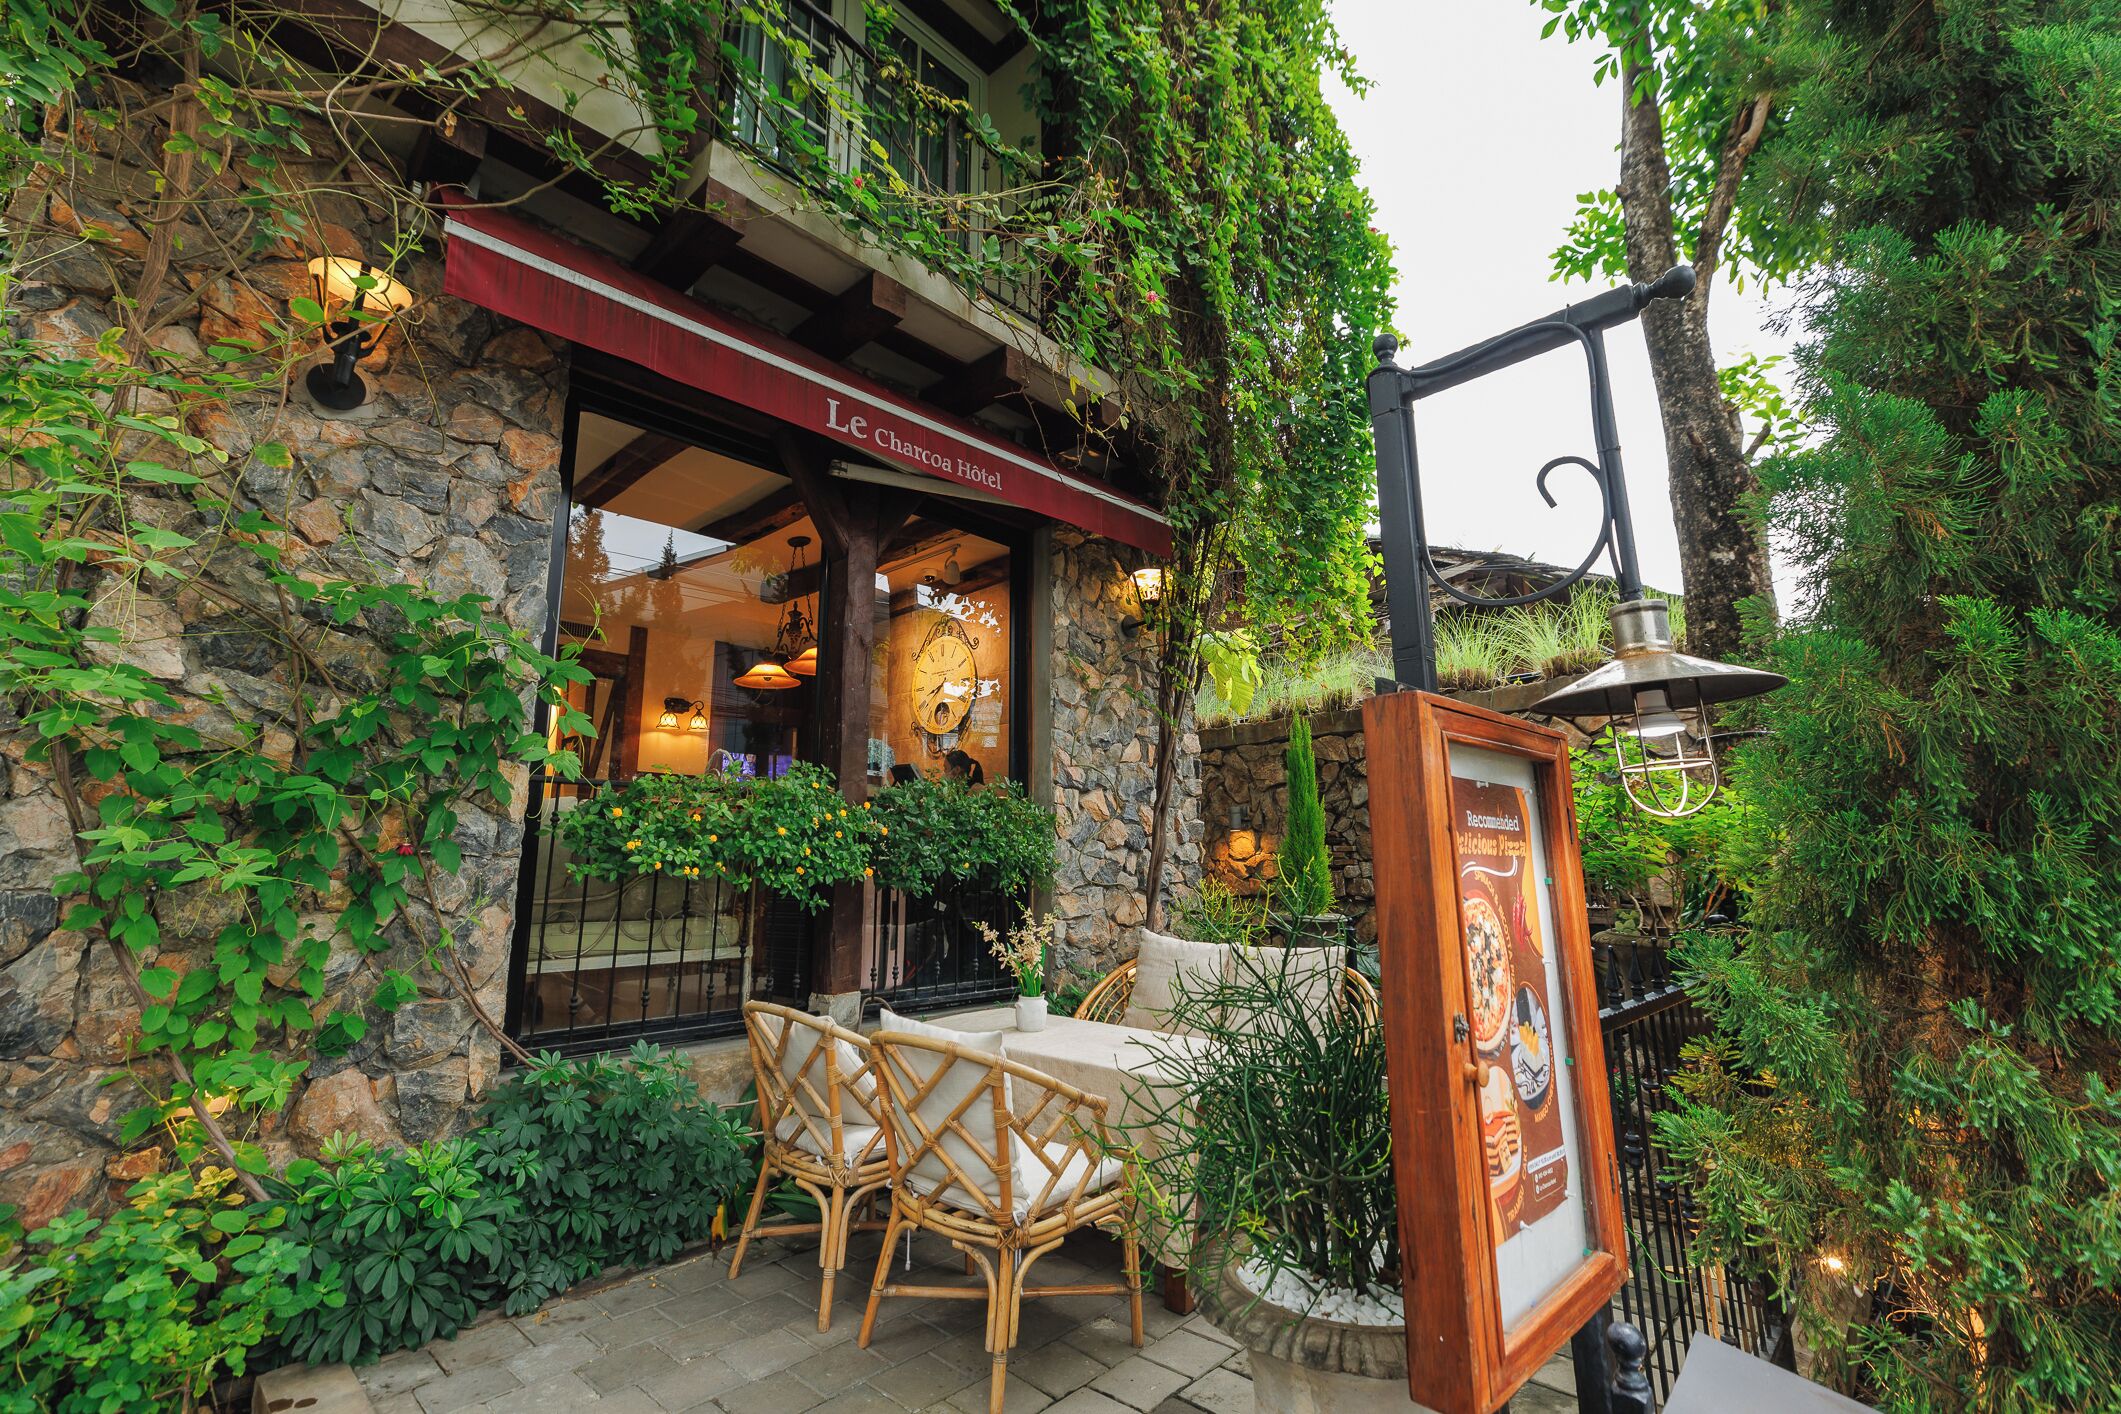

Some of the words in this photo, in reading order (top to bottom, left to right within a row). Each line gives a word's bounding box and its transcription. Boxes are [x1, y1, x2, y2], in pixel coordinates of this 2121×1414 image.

[826, 397, 868, 439] Le
[874, 427, 953, 473] Charcoa
[956, 459, 1003, 491] Hôtel
[1466, 810, 1520, 831] Recommended
[1499, 834, 1526, 857] Pizza
